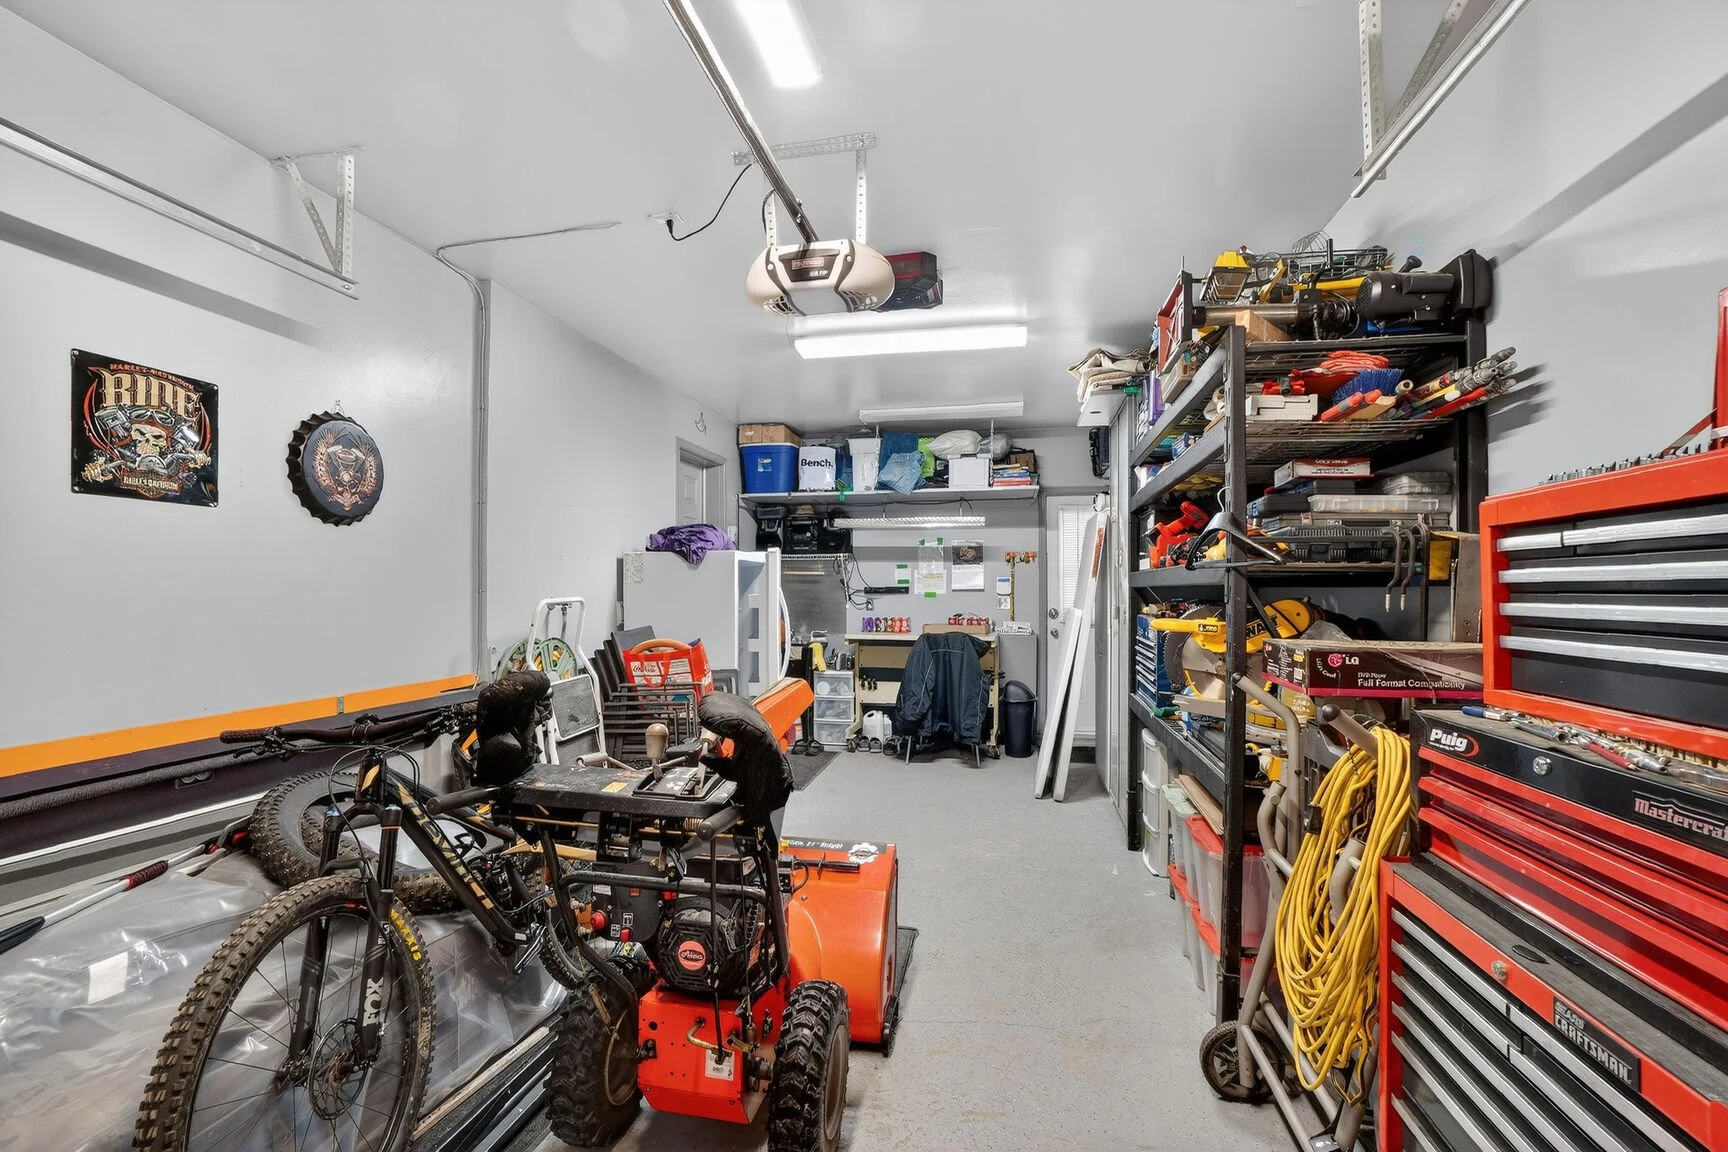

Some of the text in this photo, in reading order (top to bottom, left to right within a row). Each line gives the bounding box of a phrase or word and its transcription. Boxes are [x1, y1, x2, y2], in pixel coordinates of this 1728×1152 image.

[801, 459, 833, 467] Bench.
[1345, 656, 1360, 665] LG
[1358, 679, 1374, 687] Full
[1430, 728, 1468, 752] Puig
[362, 977, 384, 1027] FOX
